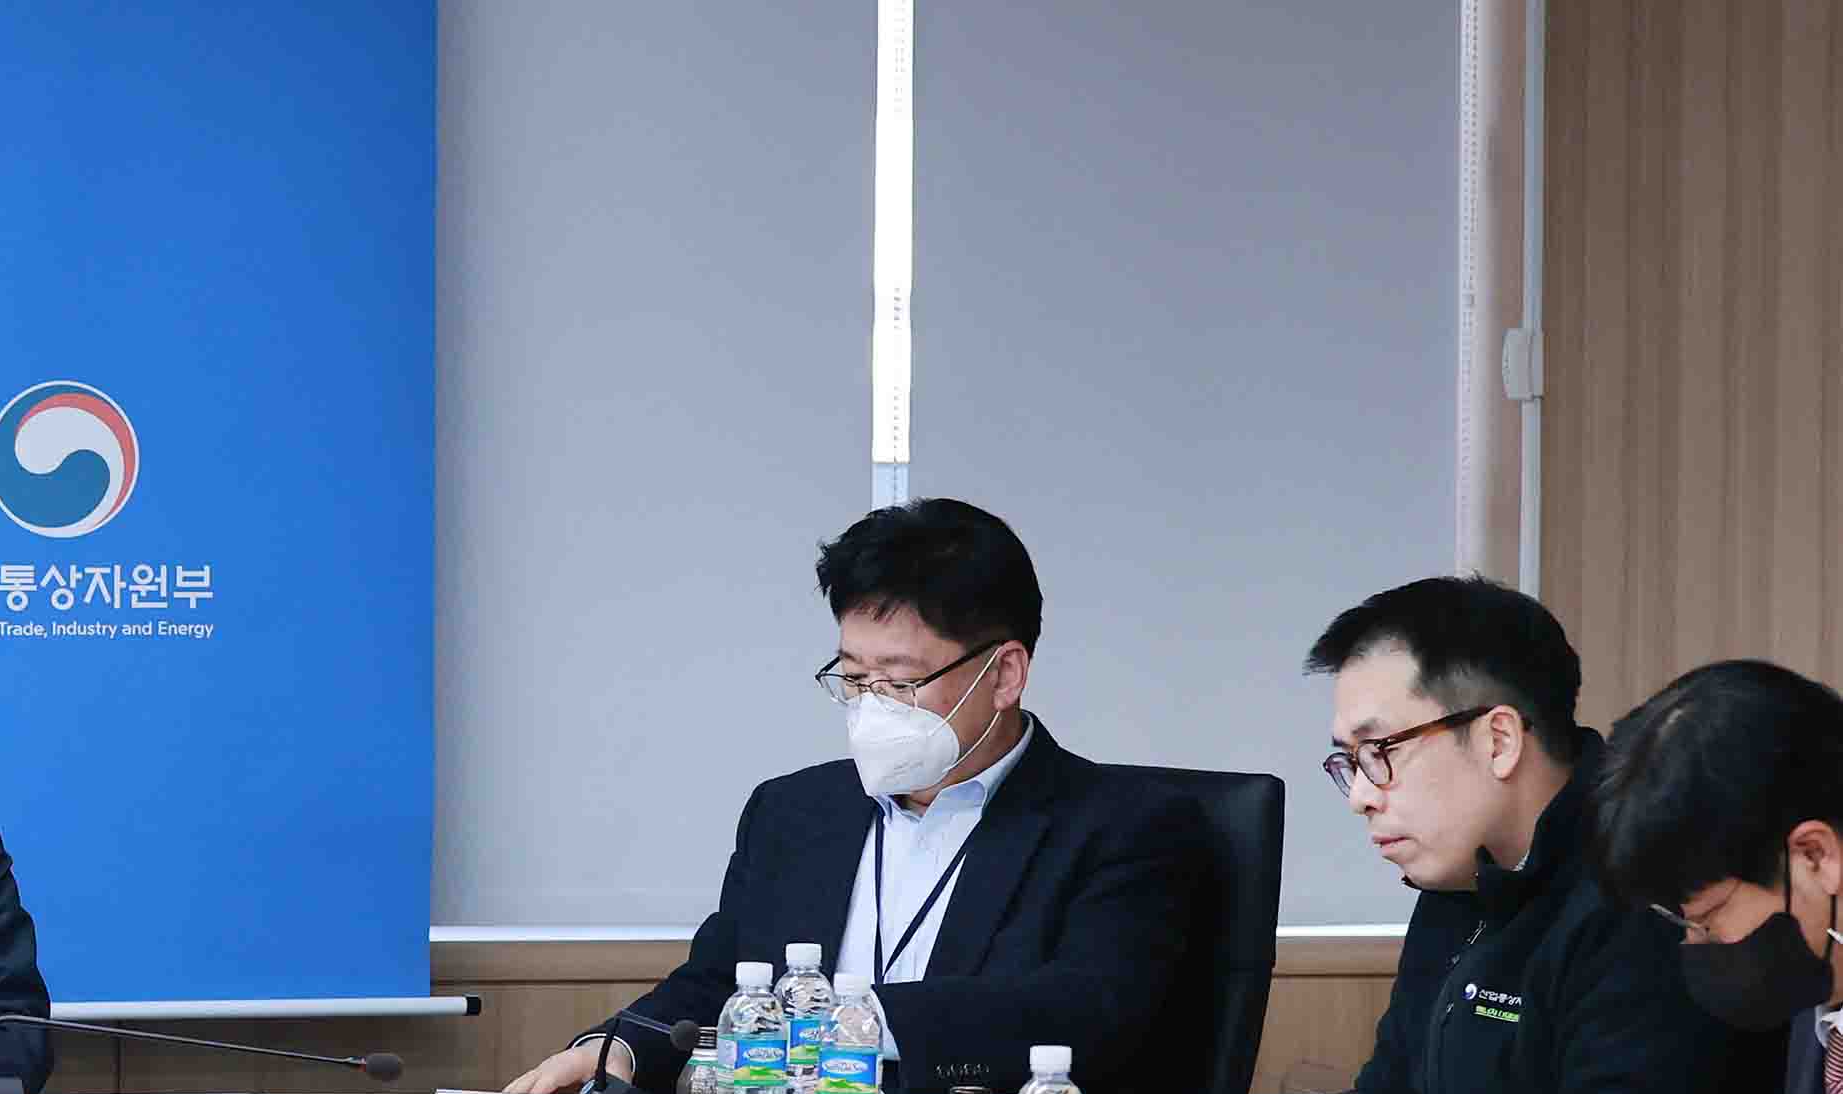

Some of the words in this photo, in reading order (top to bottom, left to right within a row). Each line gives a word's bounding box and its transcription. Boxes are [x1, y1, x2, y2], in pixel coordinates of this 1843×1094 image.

[52, 621, 117, 639] Industry
[122, 621, 153, 636] and
[157, 621, 214, 639] Energy
